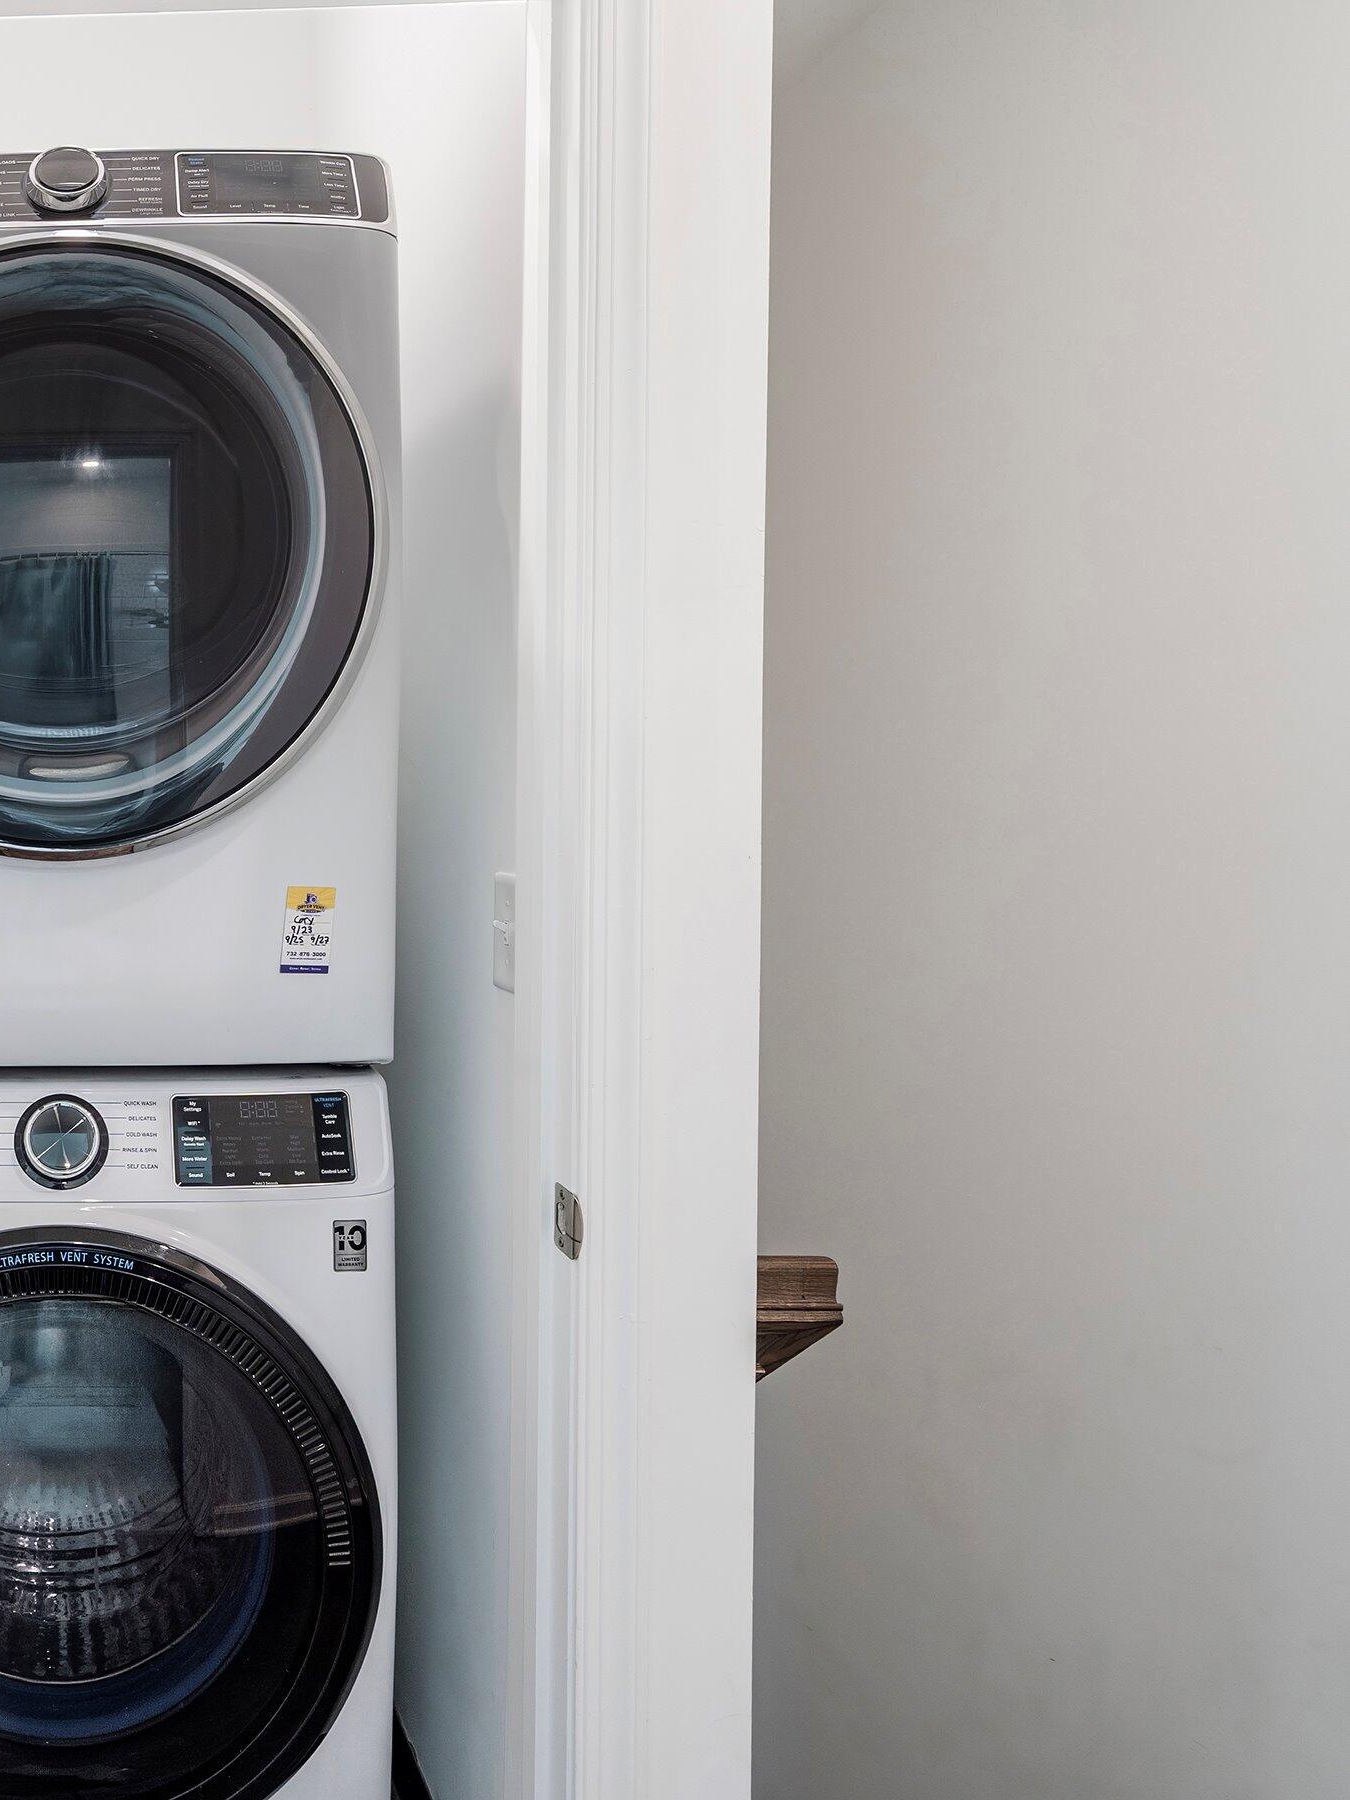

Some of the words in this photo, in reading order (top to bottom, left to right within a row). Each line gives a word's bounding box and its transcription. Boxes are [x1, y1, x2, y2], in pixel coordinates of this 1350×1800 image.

[291, 925, 312, 935] 9/23
[285, 934, 304, 945] 9/25
[310, 935, 330, 945] 9/27
[334, 1226, 366, 1250] 10
[60, 1252, 88, 1262] VENT
[94, 1254, 134, 1270] SYSTEM
